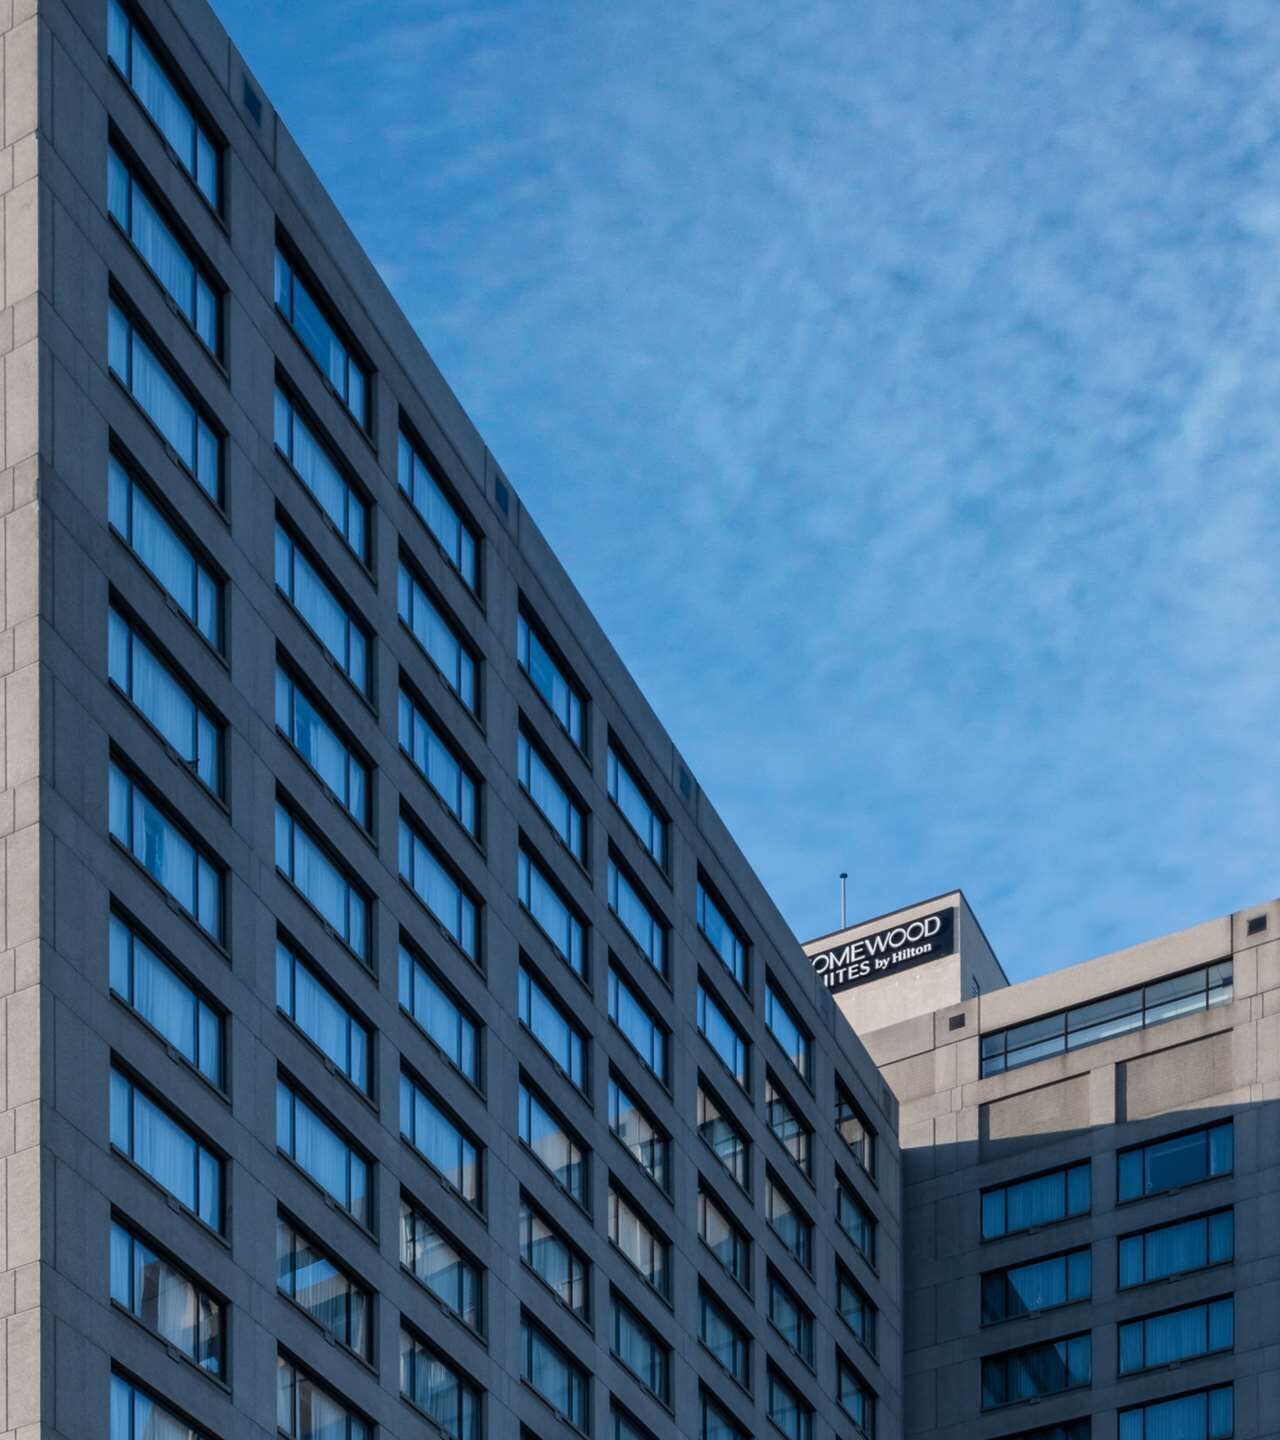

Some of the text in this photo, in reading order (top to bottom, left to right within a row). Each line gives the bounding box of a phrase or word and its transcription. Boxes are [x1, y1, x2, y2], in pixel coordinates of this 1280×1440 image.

[809, 915, 941, 974] OMEWOOD
[824, 942, 933, 988] ITES by Hilton
